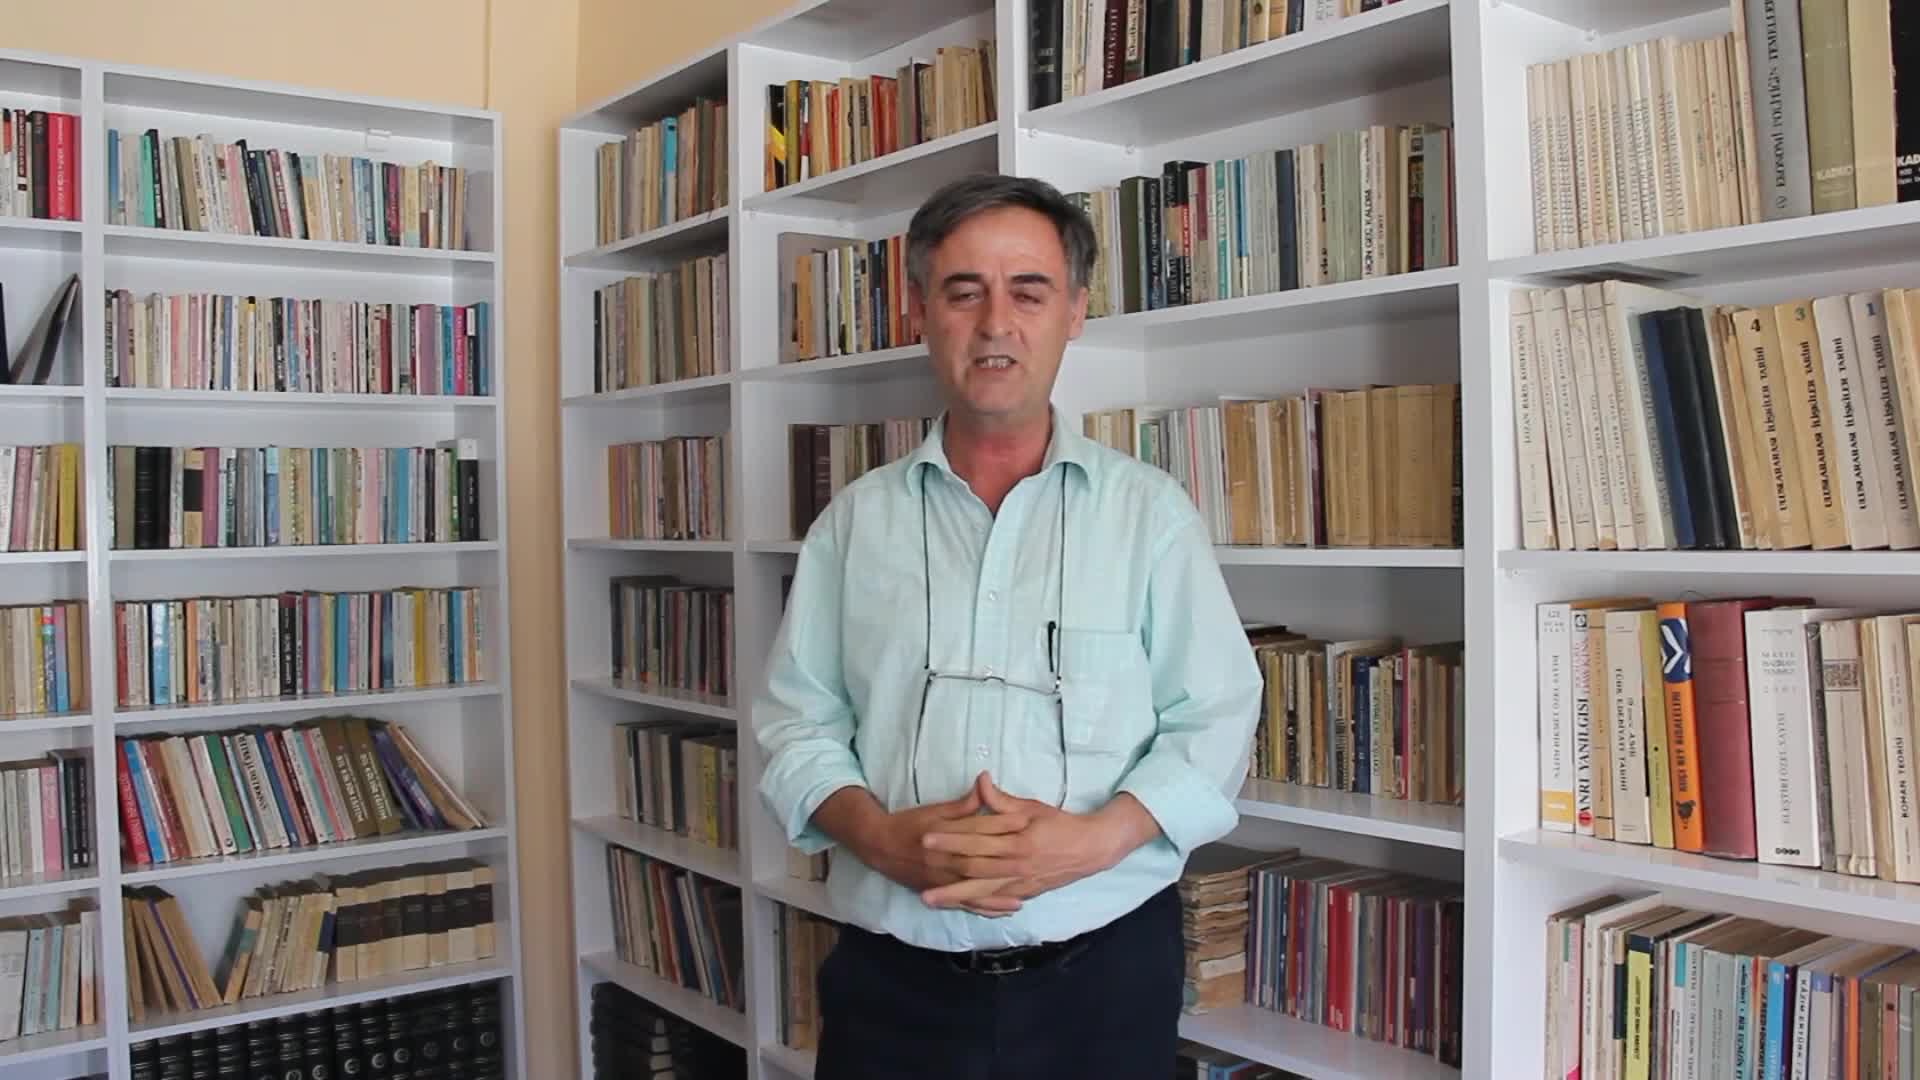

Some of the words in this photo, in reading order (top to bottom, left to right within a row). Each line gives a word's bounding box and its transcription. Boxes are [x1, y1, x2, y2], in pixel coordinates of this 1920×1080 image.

[1749, 318, 1761, 333] 4
[1794, 306, 1806, 322] 3
[1866, 302, 1877, 317] 1
[1754, 346, 1769, 380] TARİHİ
[1799, 340, 1814, 375] TARİHİ
[1832, 336, 1847, 374] TARİHİ
[1871, 334, 1886, 371] TARİHİ
[1761, 384, 1777, 433] İLİŞKİLER
[1806, 378, 1822, 428] İLİŞKİLER
[1839, 377, 1855, 427] İLİŞKİLER
[1879, 375, 1897, 427] İLİŞKİLER
[1770, 436, 1788, 511] ULUSLARARASI
[1813, 432, 1833, 508] ULUSLARARASI
[1848, 431, 1867, 510] ULUSLARARASI
[1889, 430, 1909, 510] ULUSLARARASI
[1576, 697, 1590, 771] YANILGISI
[1900, 779, 1909, 818] ROMAN
